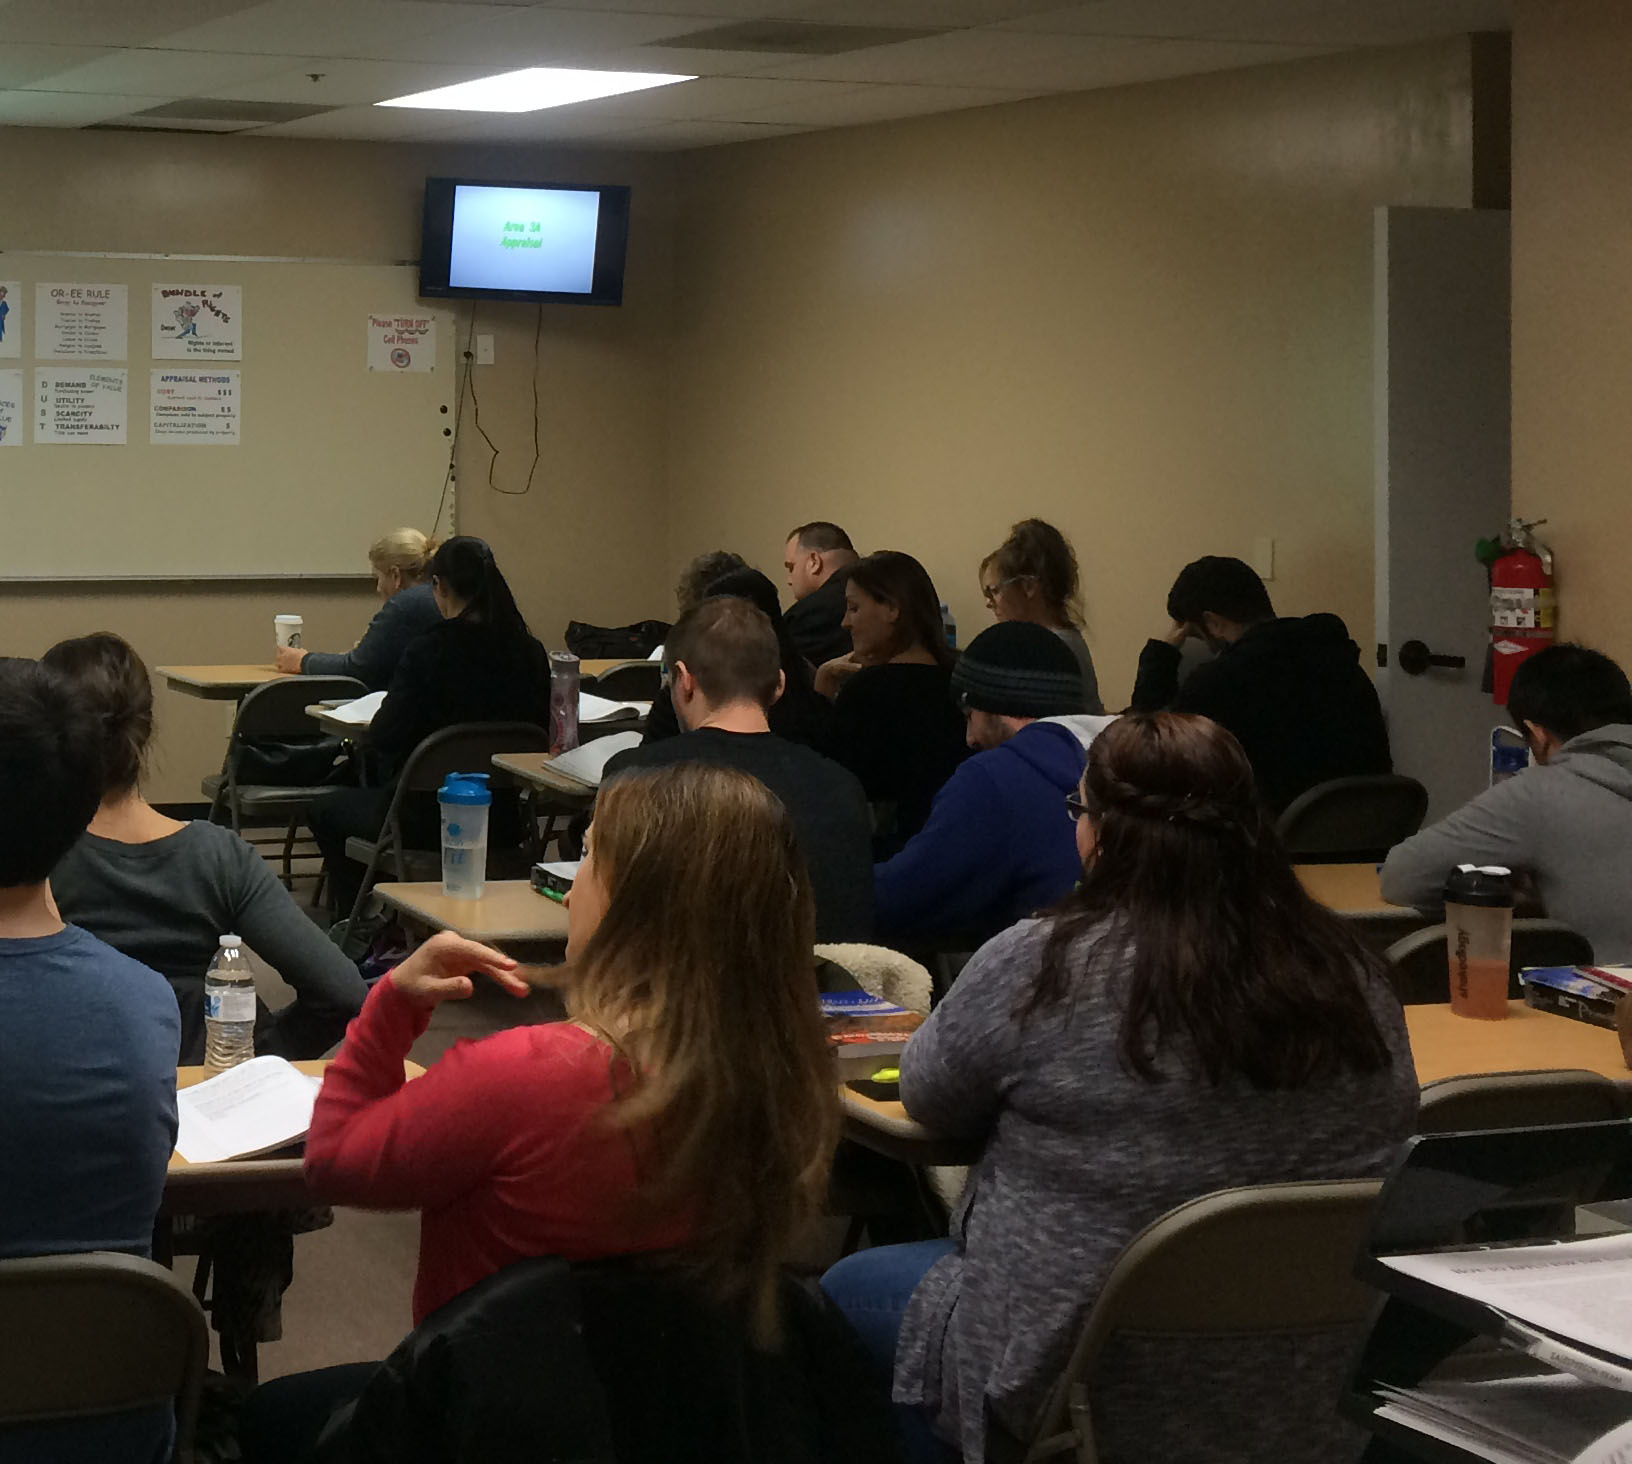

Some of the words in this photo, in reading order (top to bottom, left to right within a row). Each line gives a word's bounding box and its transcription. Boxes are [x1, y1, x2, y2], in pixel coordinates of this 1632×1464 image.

[500, 236, 543, 249] Appraisal
[86, 288, 111, 299] RULE
[160, 289, 207, 298] BUNDLE
[372, 318, 393, 328] Please
[383, 334, 396, 345] Cell
[396, 335, 419, 345] Phones
[160, 375, 198, 383] APPRAISAL
[198, 376, 231, 384] METHODS
[41, 381, 48, 389] D
[55, 381, 87, 389] DEMAND
[40, 395, 48, 403] U
